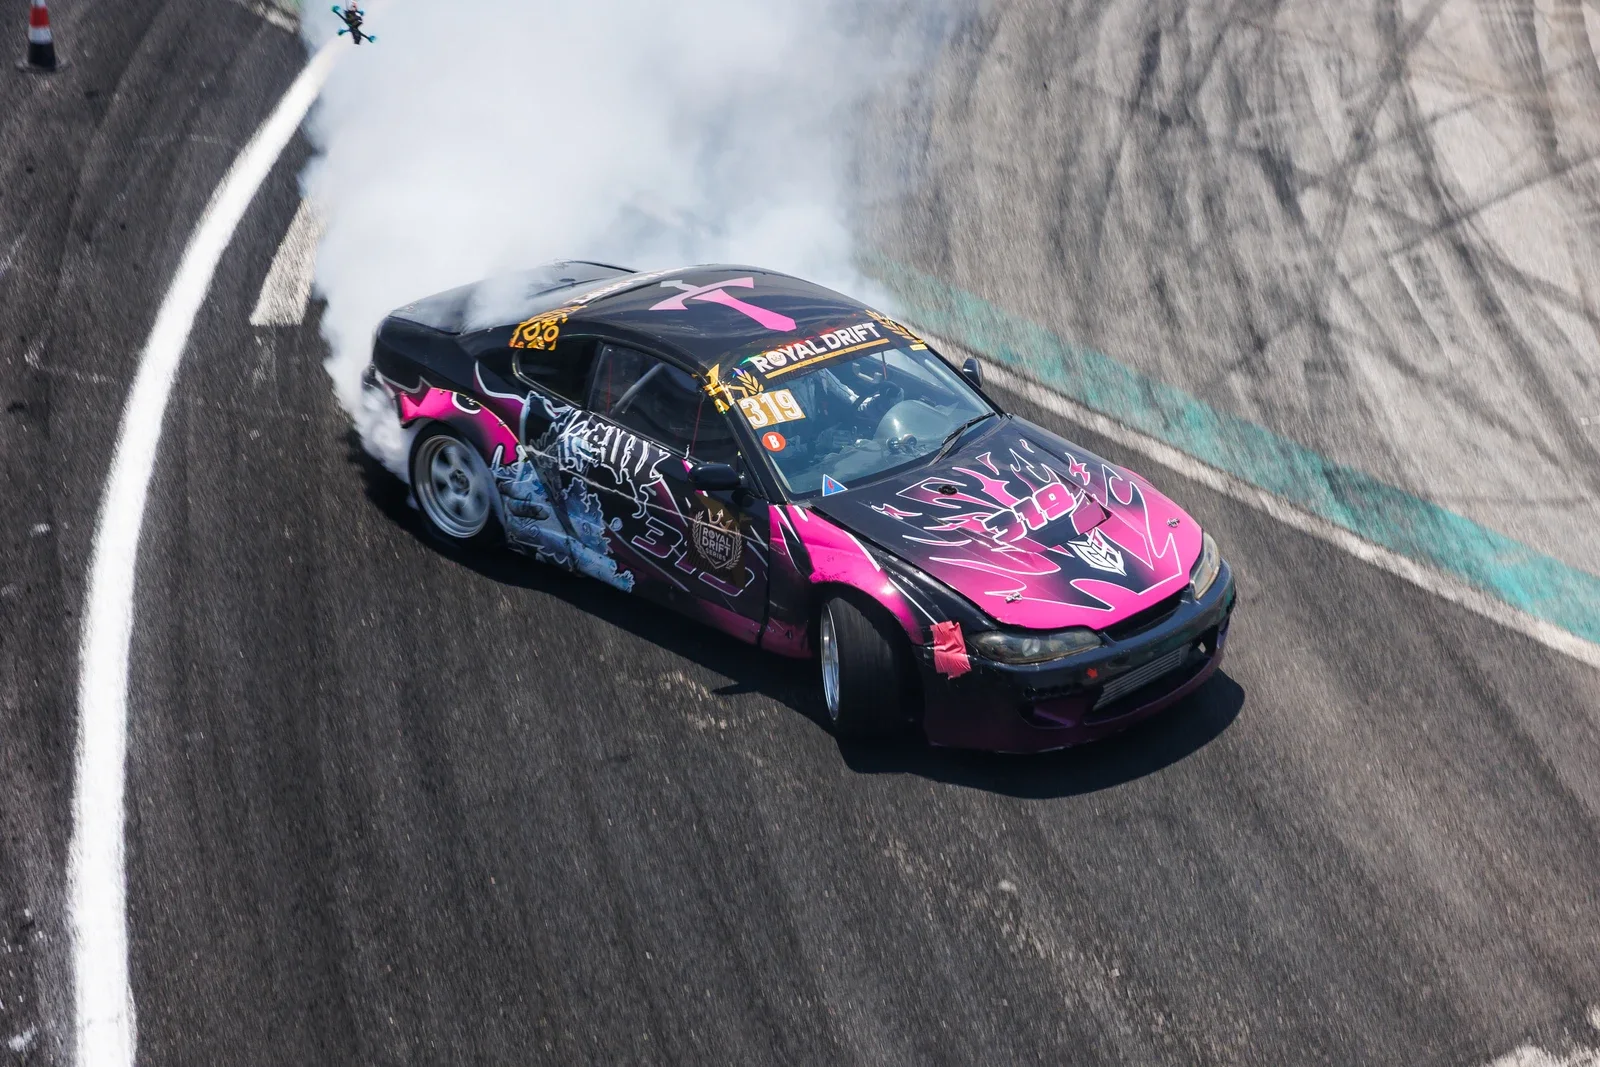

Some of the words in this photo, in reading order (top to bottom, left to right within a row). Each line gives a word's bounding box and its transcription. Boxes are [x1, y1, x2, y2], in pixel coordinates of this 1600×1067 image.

[750, 340, 827, 373] ROYAL
[820, 322, 881, 350] DRIFT
[741, 390, 803, 426] 319
[767, 434, 780, 449] B
[981, 482, 1077, 545] 319
[702, 527, 731, 547] ROYAL
[702, 536, 731, 556] DRIFT
